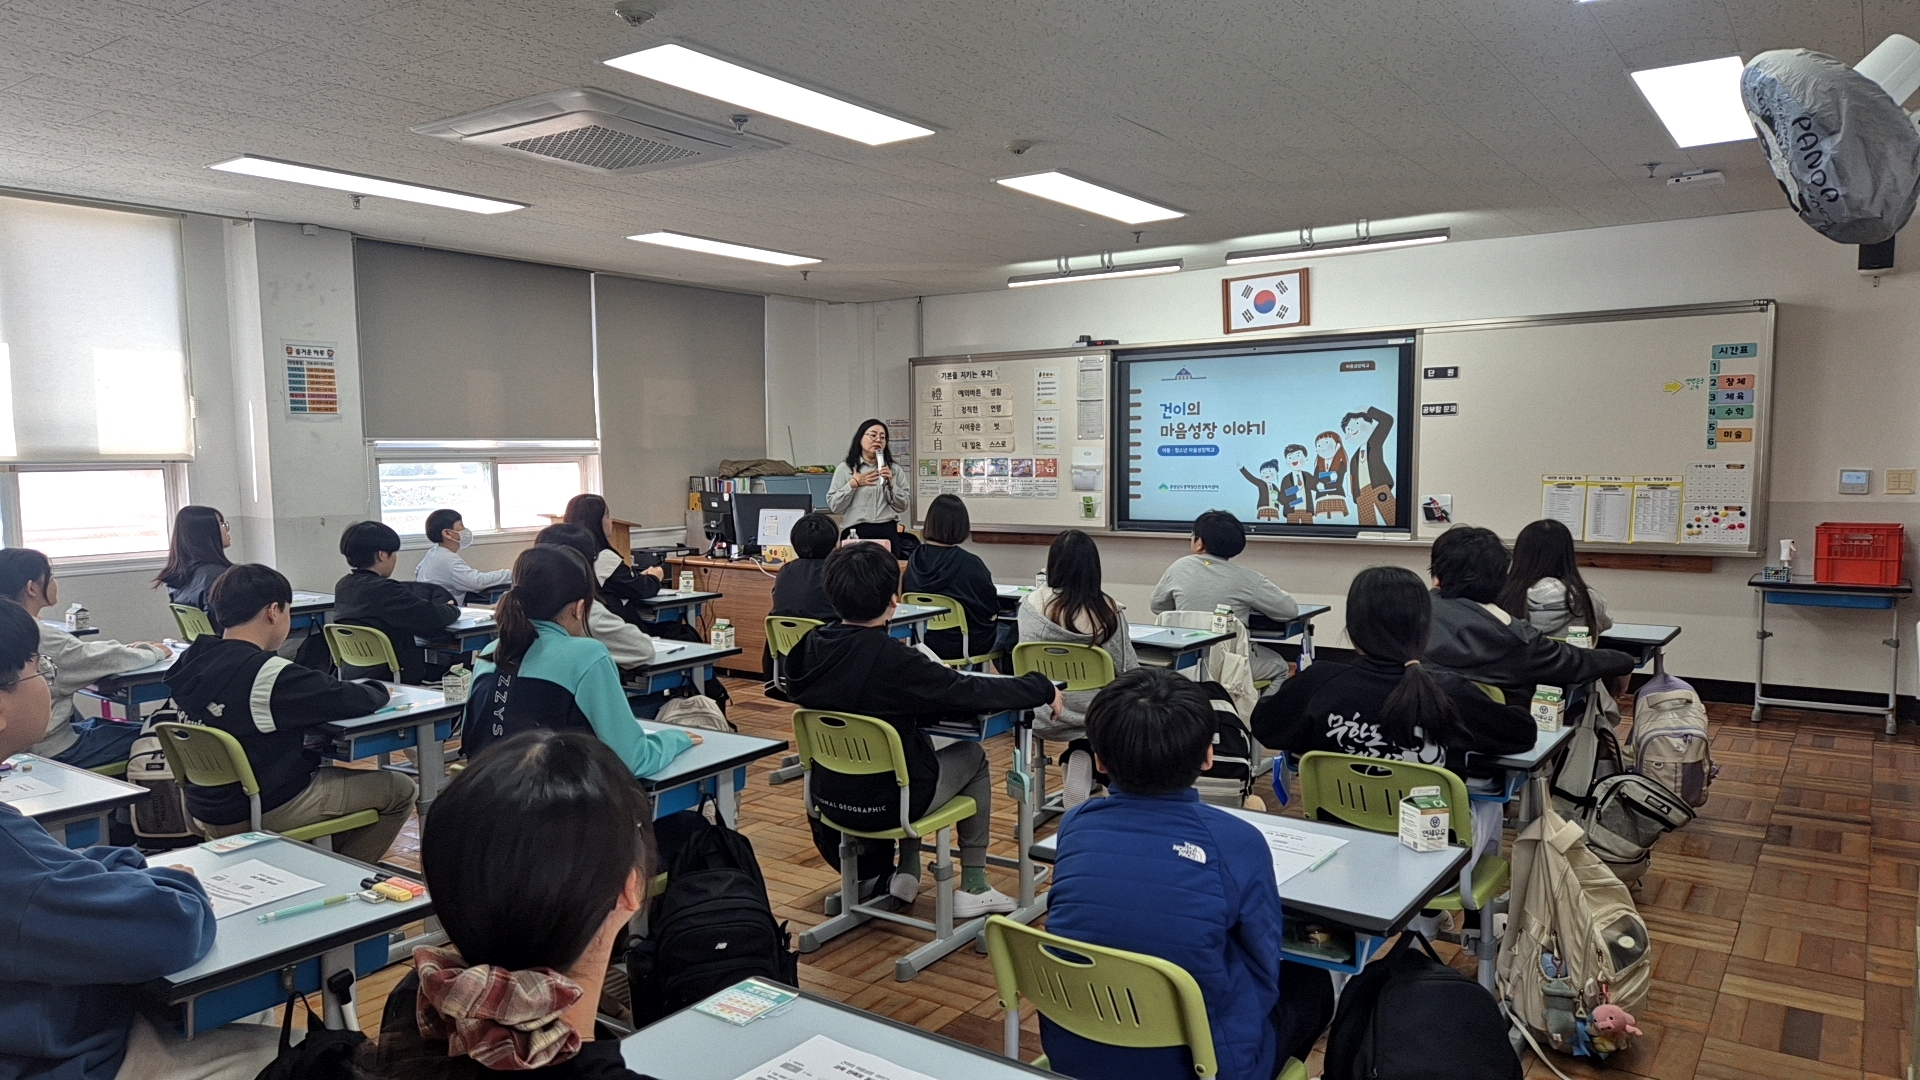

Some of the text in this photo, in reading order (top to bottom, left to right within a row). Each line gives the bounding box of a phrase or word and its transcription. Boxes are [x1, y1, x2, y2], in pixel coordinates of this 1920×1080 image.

[1792, 116, 1839, 202] PANDA
[1719, 346, 1749, 355] 시간표
[941, 370, 993, 380] 기본을 지키는 우리
[931, 388, 943, 401] 禮
[958, 388, 1002, 397] 예의바른 생활
[932, 405, 942, 417] 正
[961, 404, 1002, 414] 정직한 언행
[1160, 402, 1200, 419] 건이의
[932, 421, 943, 434] 友
[994, 422, 1000, 430] 벗
[1160, 421, 1266, 440] 마음성장 이야기
[933, 438, 942, 451] 自
[1707, 438, 1714, 446] 6
[1326, 712, 1397, 747] 무한도
[820, 798, 887, 813] ONAL GEOGRAPHIC
[1422, 829, 1446, 838] 연세우유
